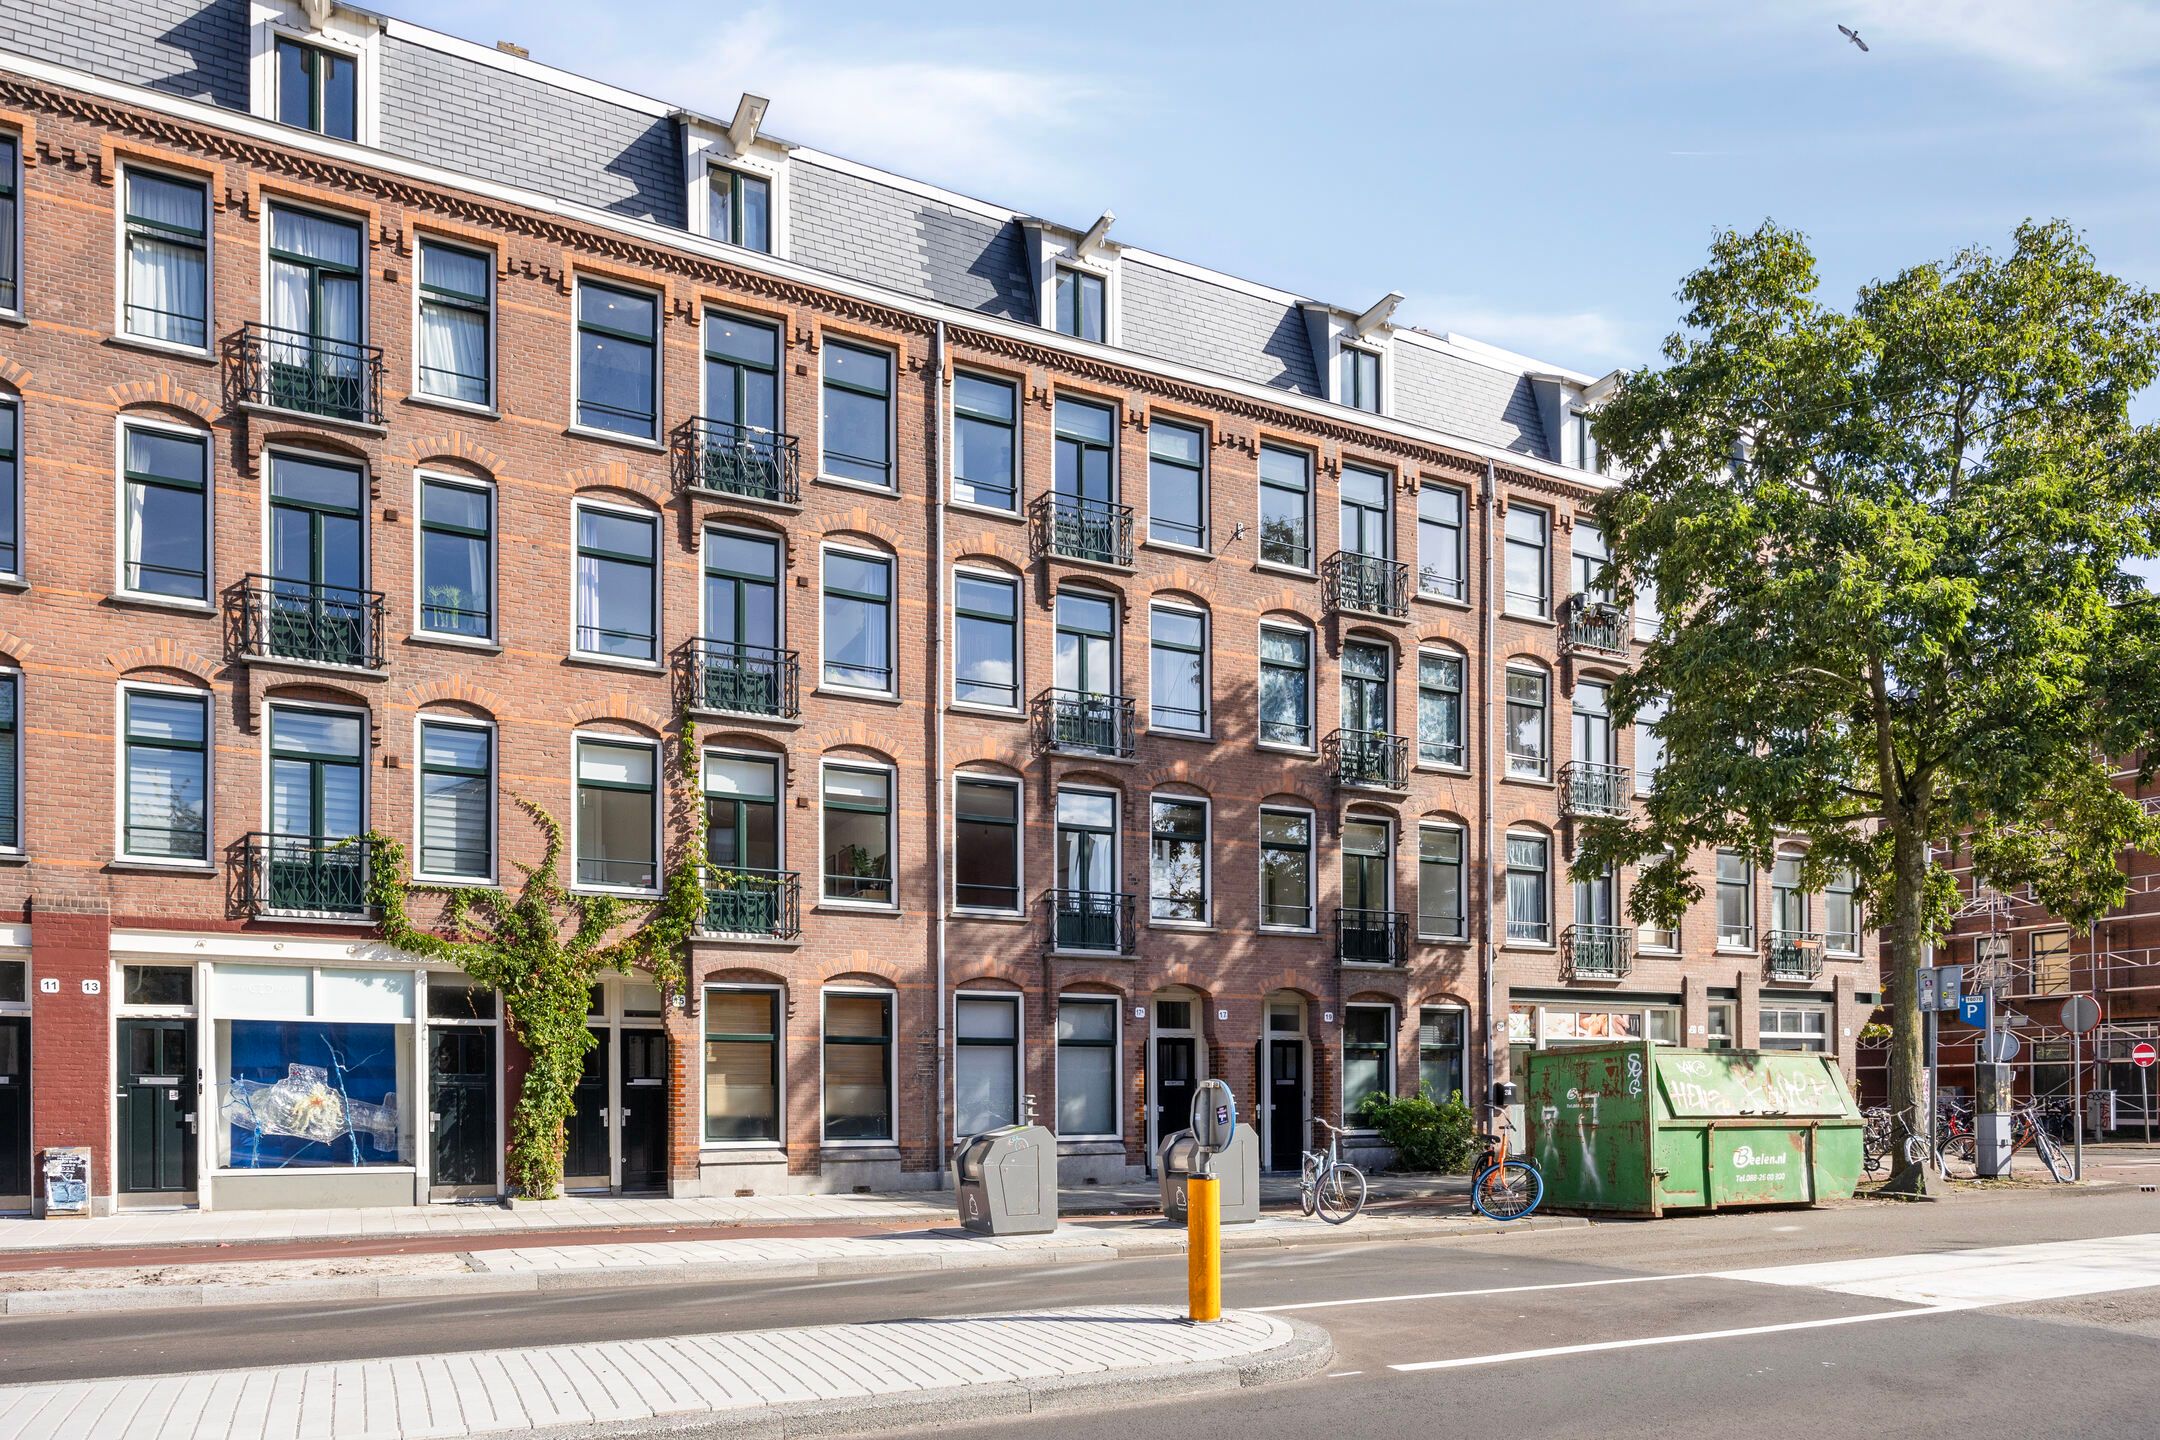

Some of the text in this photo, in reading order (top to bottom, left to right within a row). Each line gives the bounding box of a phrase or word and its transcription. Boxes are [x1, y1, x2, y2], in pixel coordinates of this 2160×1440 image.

[43, 981, 57, 990] 11
[84, 982, 98, 991] 13
[1967, 1004, 1978, 1018] P
[1733, 1145, 1786, 1168] Beelen.nl
